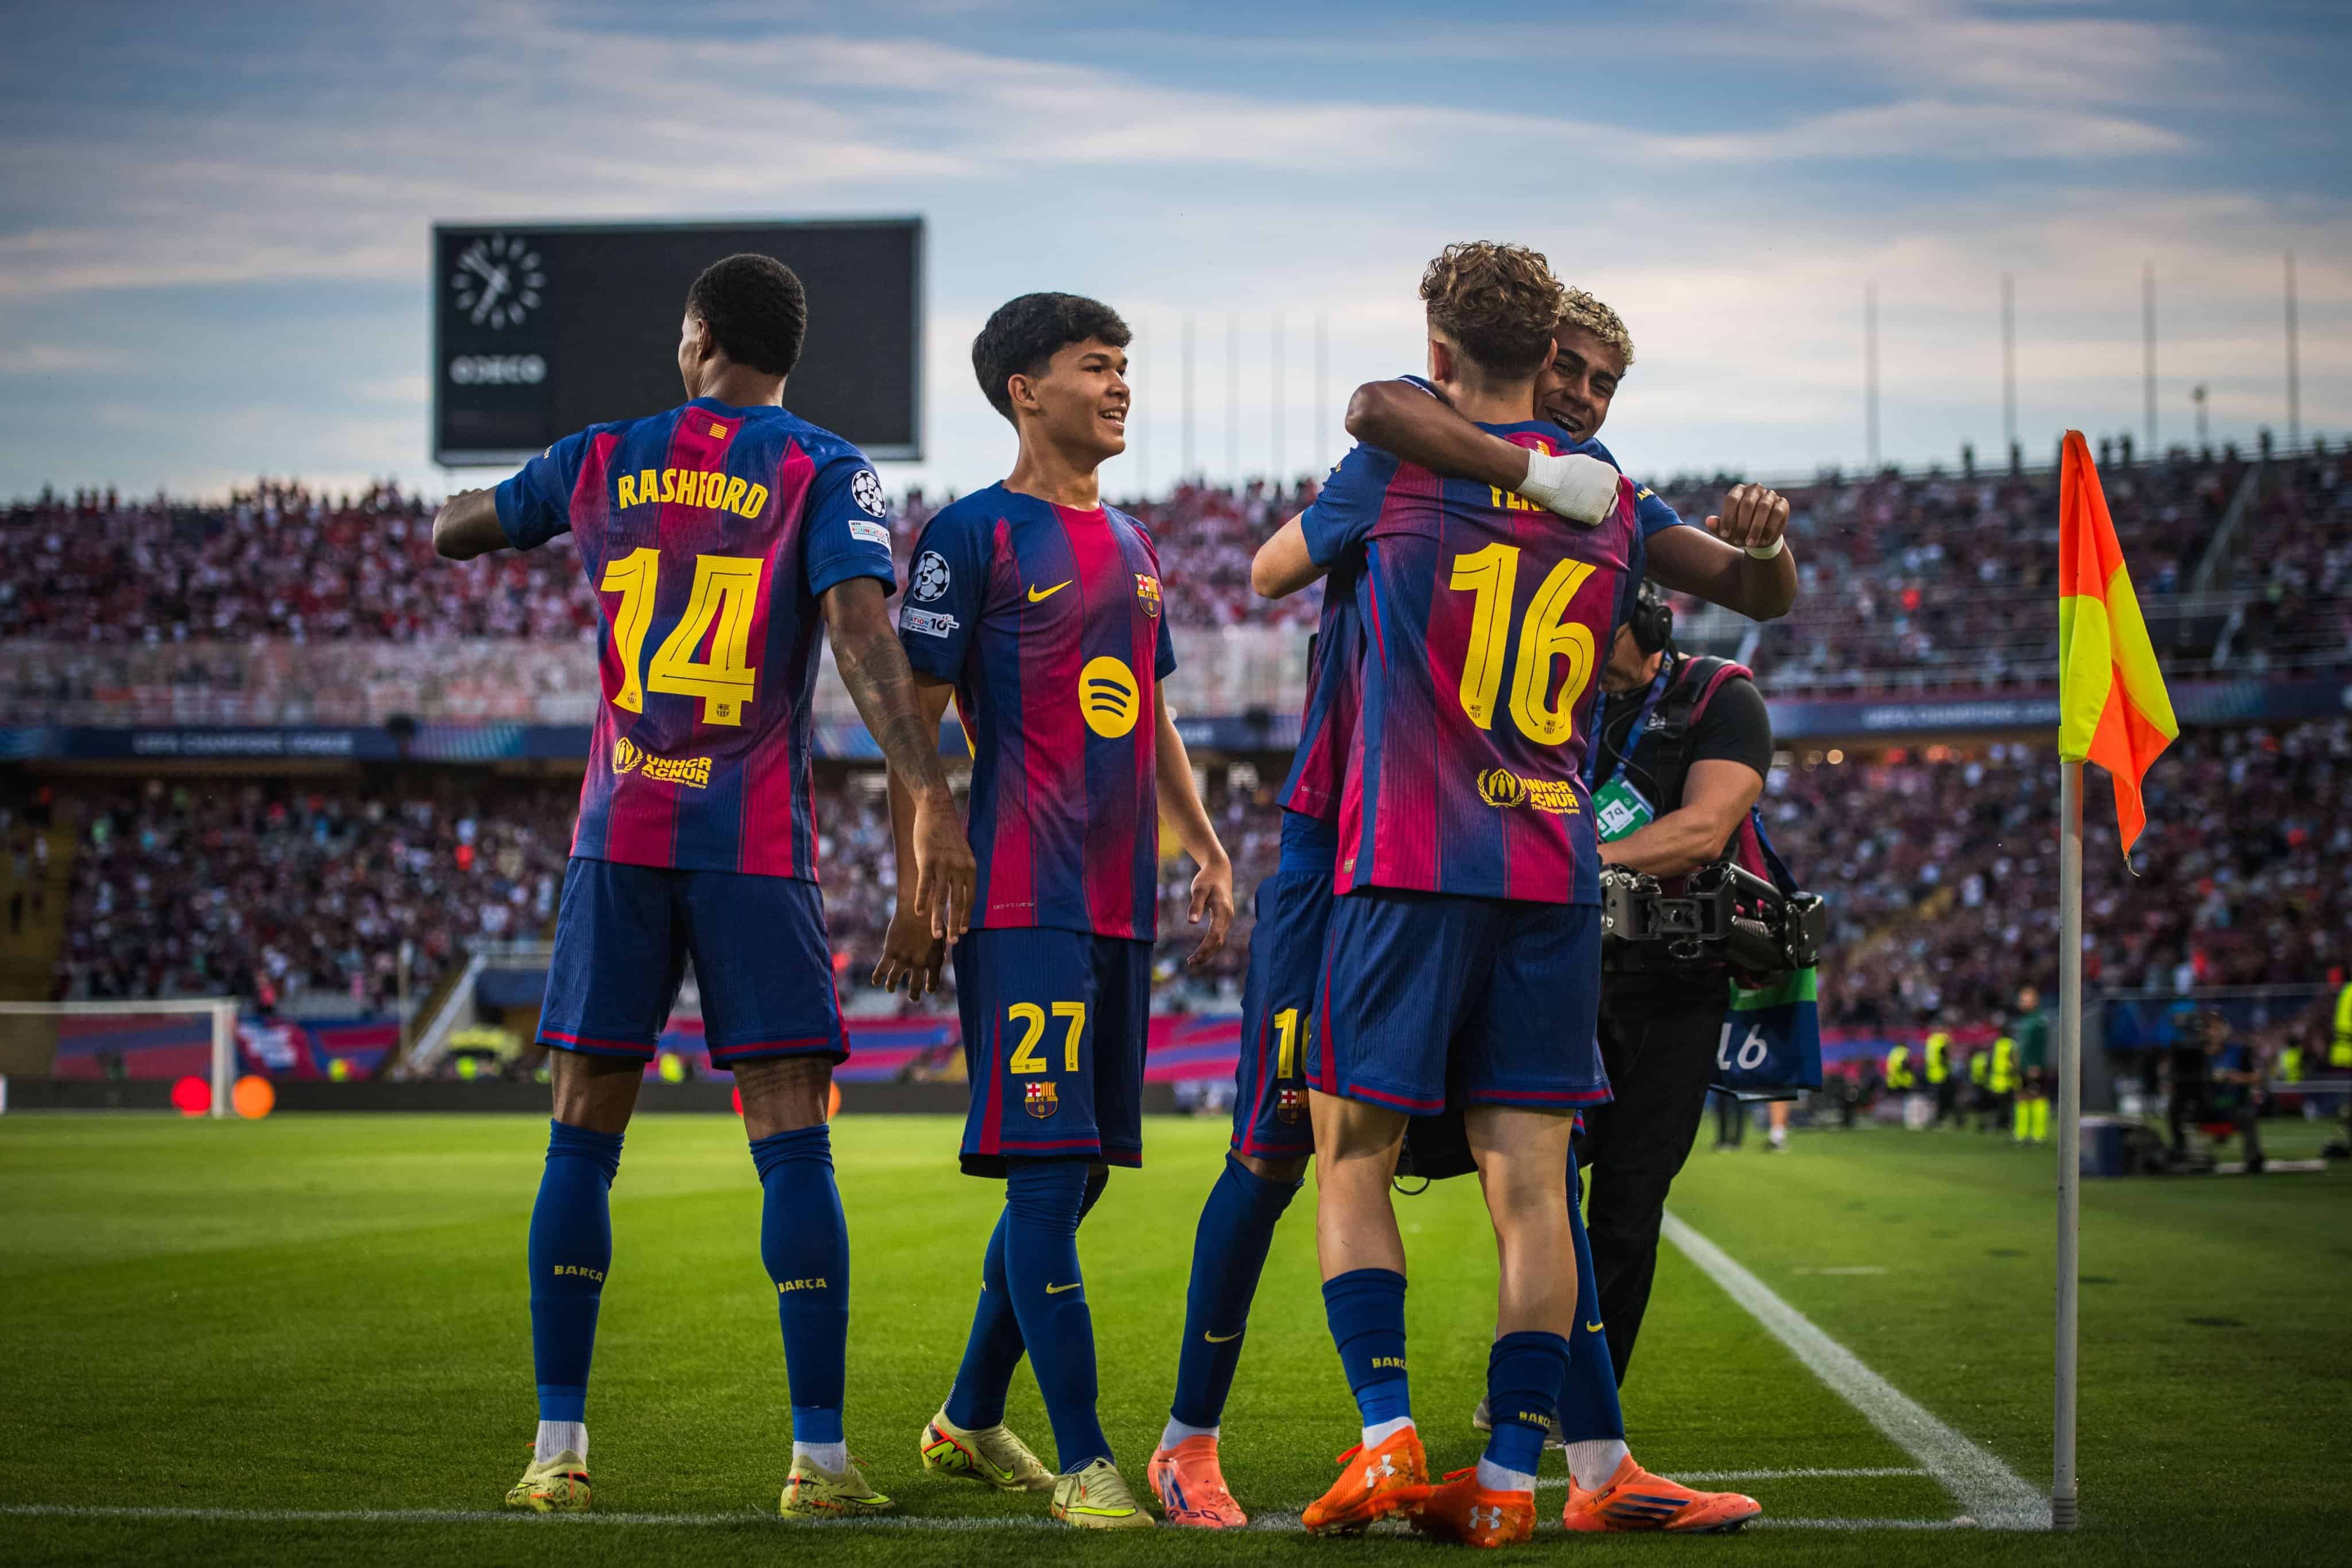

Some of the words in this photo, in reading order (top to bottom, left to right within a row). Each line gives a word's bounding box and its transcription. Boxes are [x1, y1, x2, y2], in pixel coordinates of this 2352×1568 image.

[618, 468, 768, 519] RASHFORD
[600, 547, 764, 726] 14
[1449, 542, 1597, 746] 16
[641, 763, 709, 785] ACNUR
[646, 753, 712, 771] UNHCR
[1008, 1001, 1085, 1074] 27
